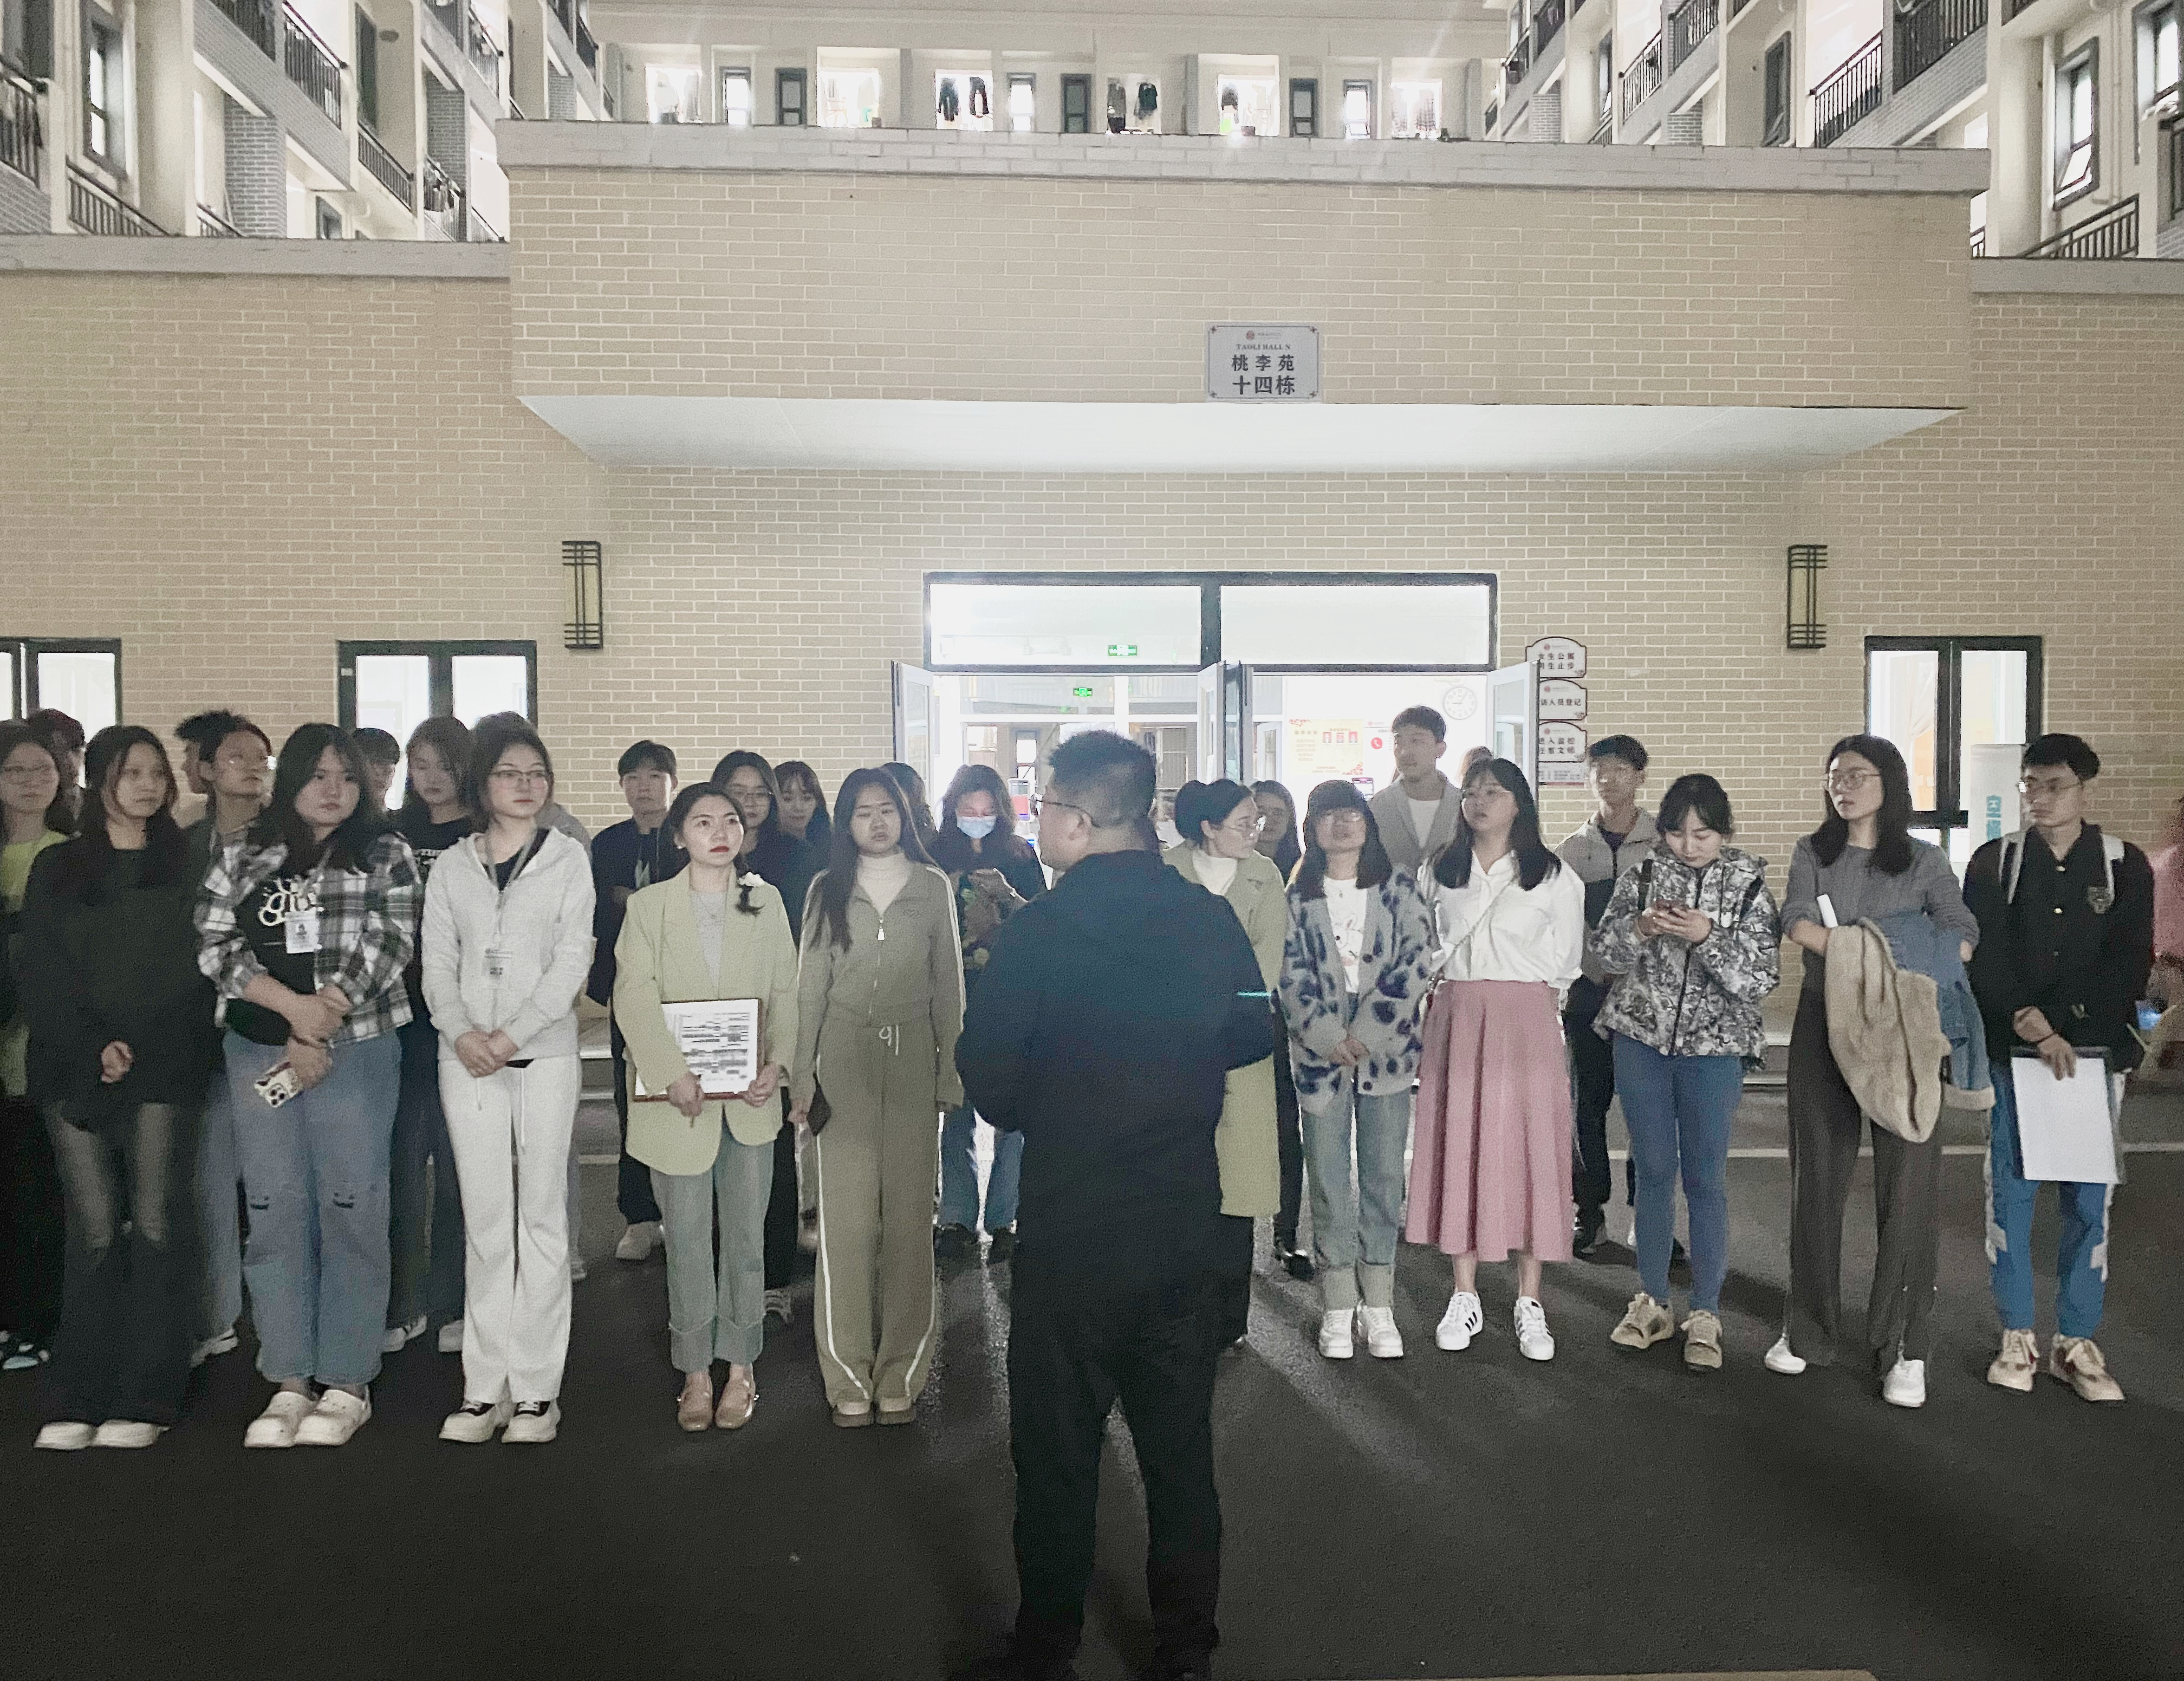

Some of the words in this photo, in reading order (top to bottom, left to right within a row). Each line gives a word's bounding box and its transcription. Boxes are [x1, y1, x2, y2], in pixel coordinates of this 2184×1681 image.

[1231, 354, 1295, 372] 桃李苑
[1232, 375, 1296, 395] 十四栋
[1540, 698, 1581, 706] 访人员登记
